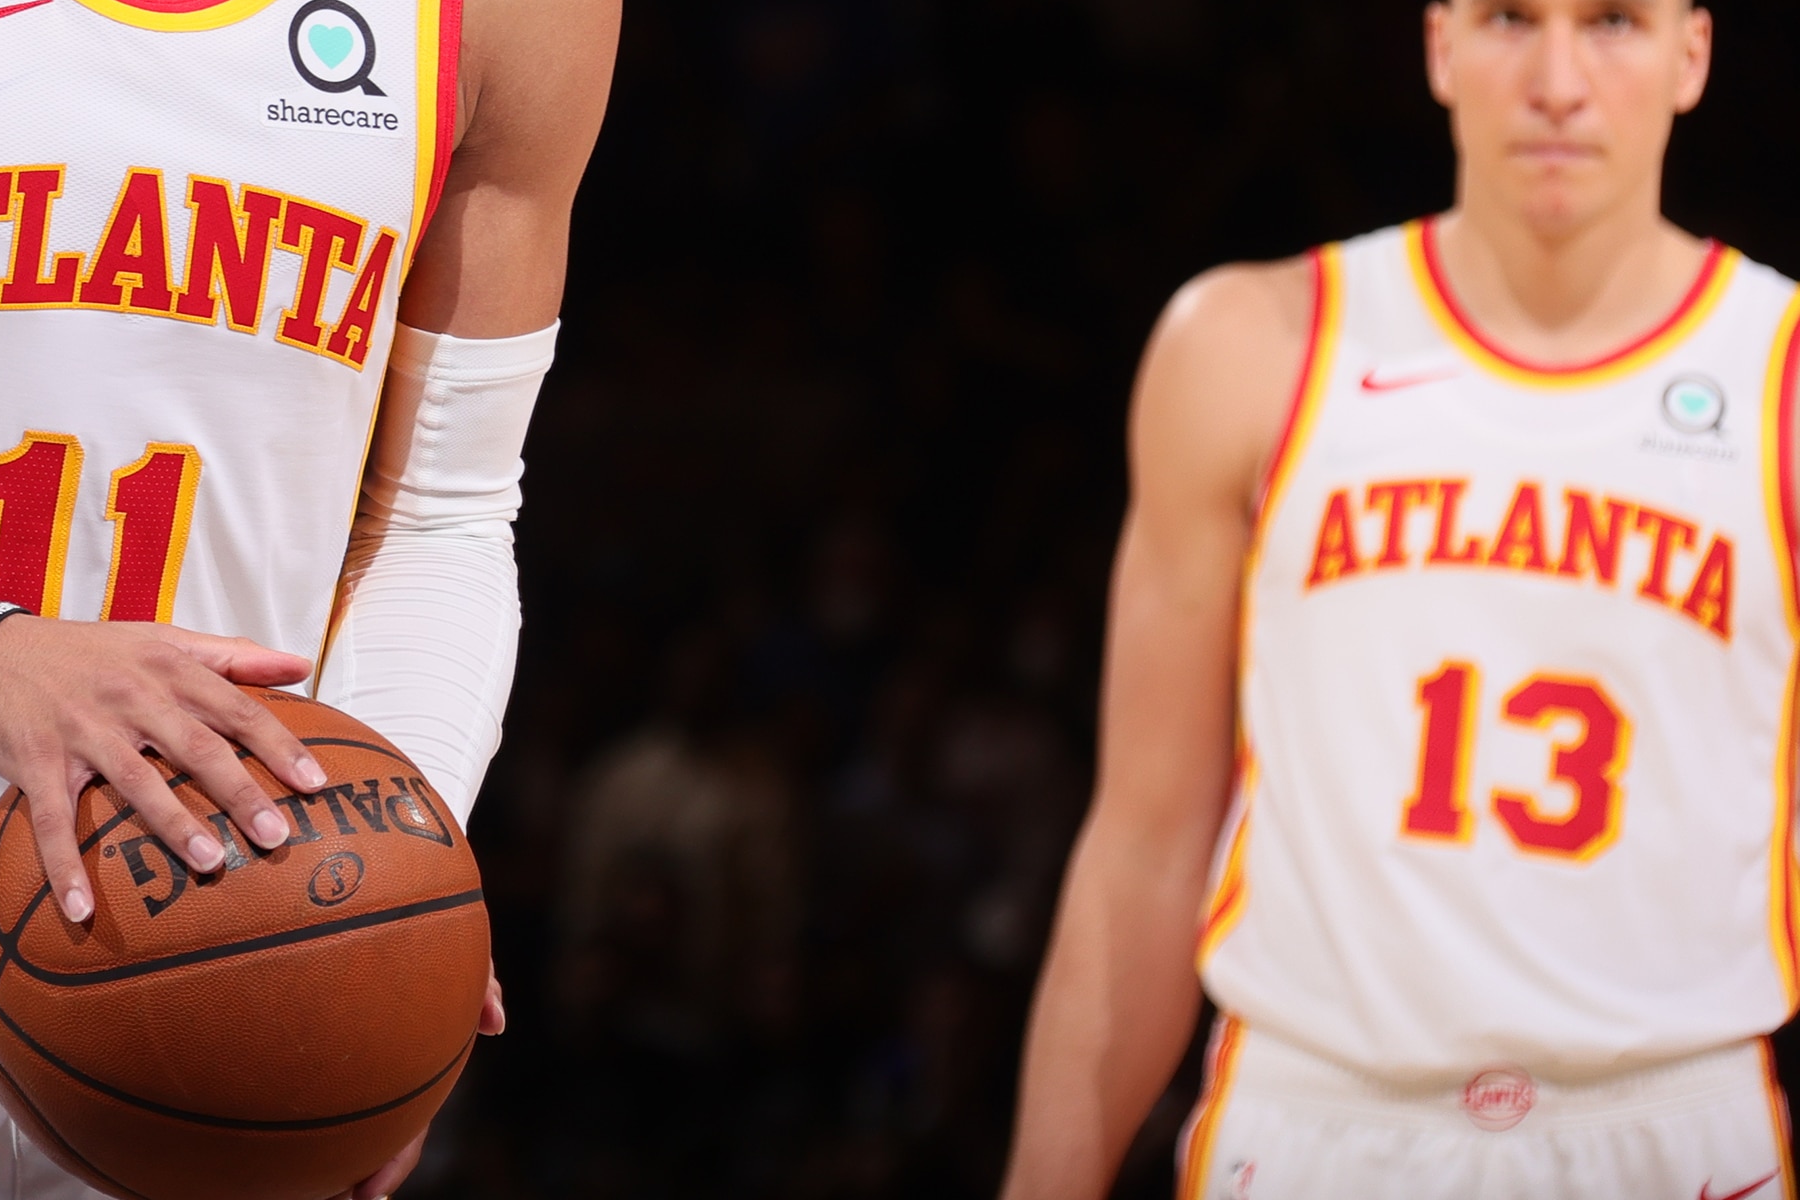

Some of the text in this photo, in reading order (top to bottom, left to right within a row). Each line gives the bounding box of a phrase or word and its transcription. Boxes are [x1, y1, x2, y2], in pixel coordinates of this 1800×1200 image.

[267, 99, 399, 131] sharecare
[1302, 473, 1739, 646] ATLANTA
[1398, 657, 1636, 867] 13
[118, 776, 454, 918] SPALDG
